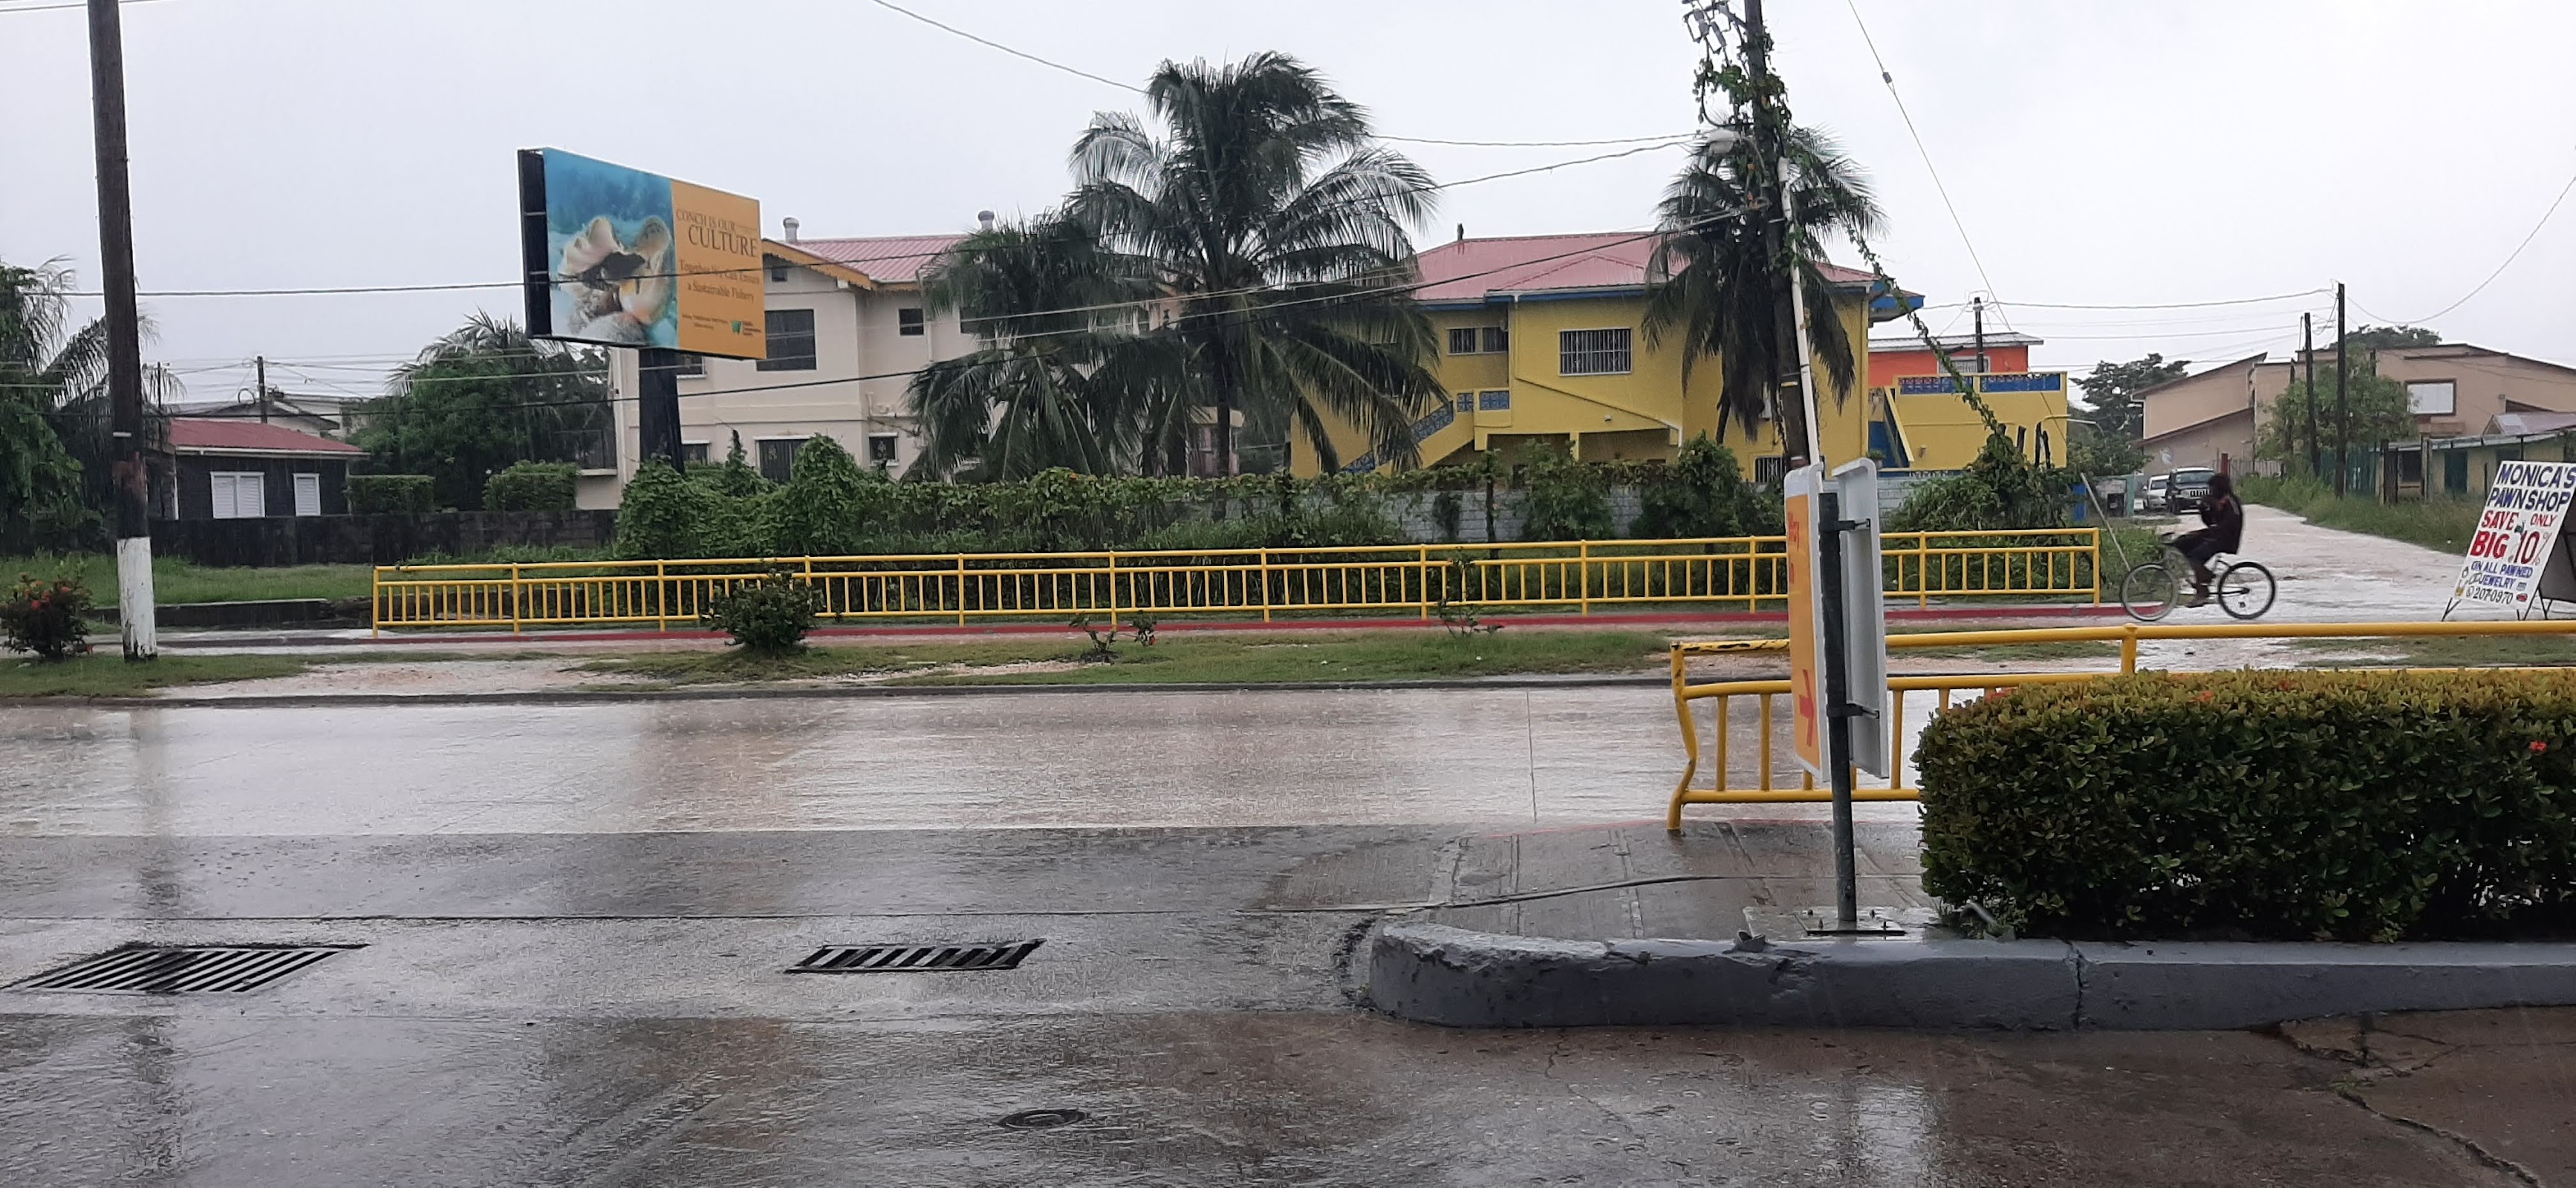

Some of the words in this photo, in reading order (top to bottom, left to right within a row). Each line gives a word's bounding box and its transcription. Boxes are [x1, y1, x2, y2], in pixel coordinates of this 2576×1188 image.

[708, 216, 717, 228] IS
[718, 218, 735, 231] OUR
[688, 224, 758, 258] CULTURE
[2496, 463, 2576, 489] MONICA'S
[2481, 509, 2520, 530] SAVE
[2530, 513, 2557, 527] ONLY
[2470, 530, 2510, 558] BIG
[2471, 561, 2484, 572] ON
[2483, 562, 2498, 574] ALL
[2499, 564, 2534, 578] PAWNED
[2479, 575, 2517, 590] JEWELRY
